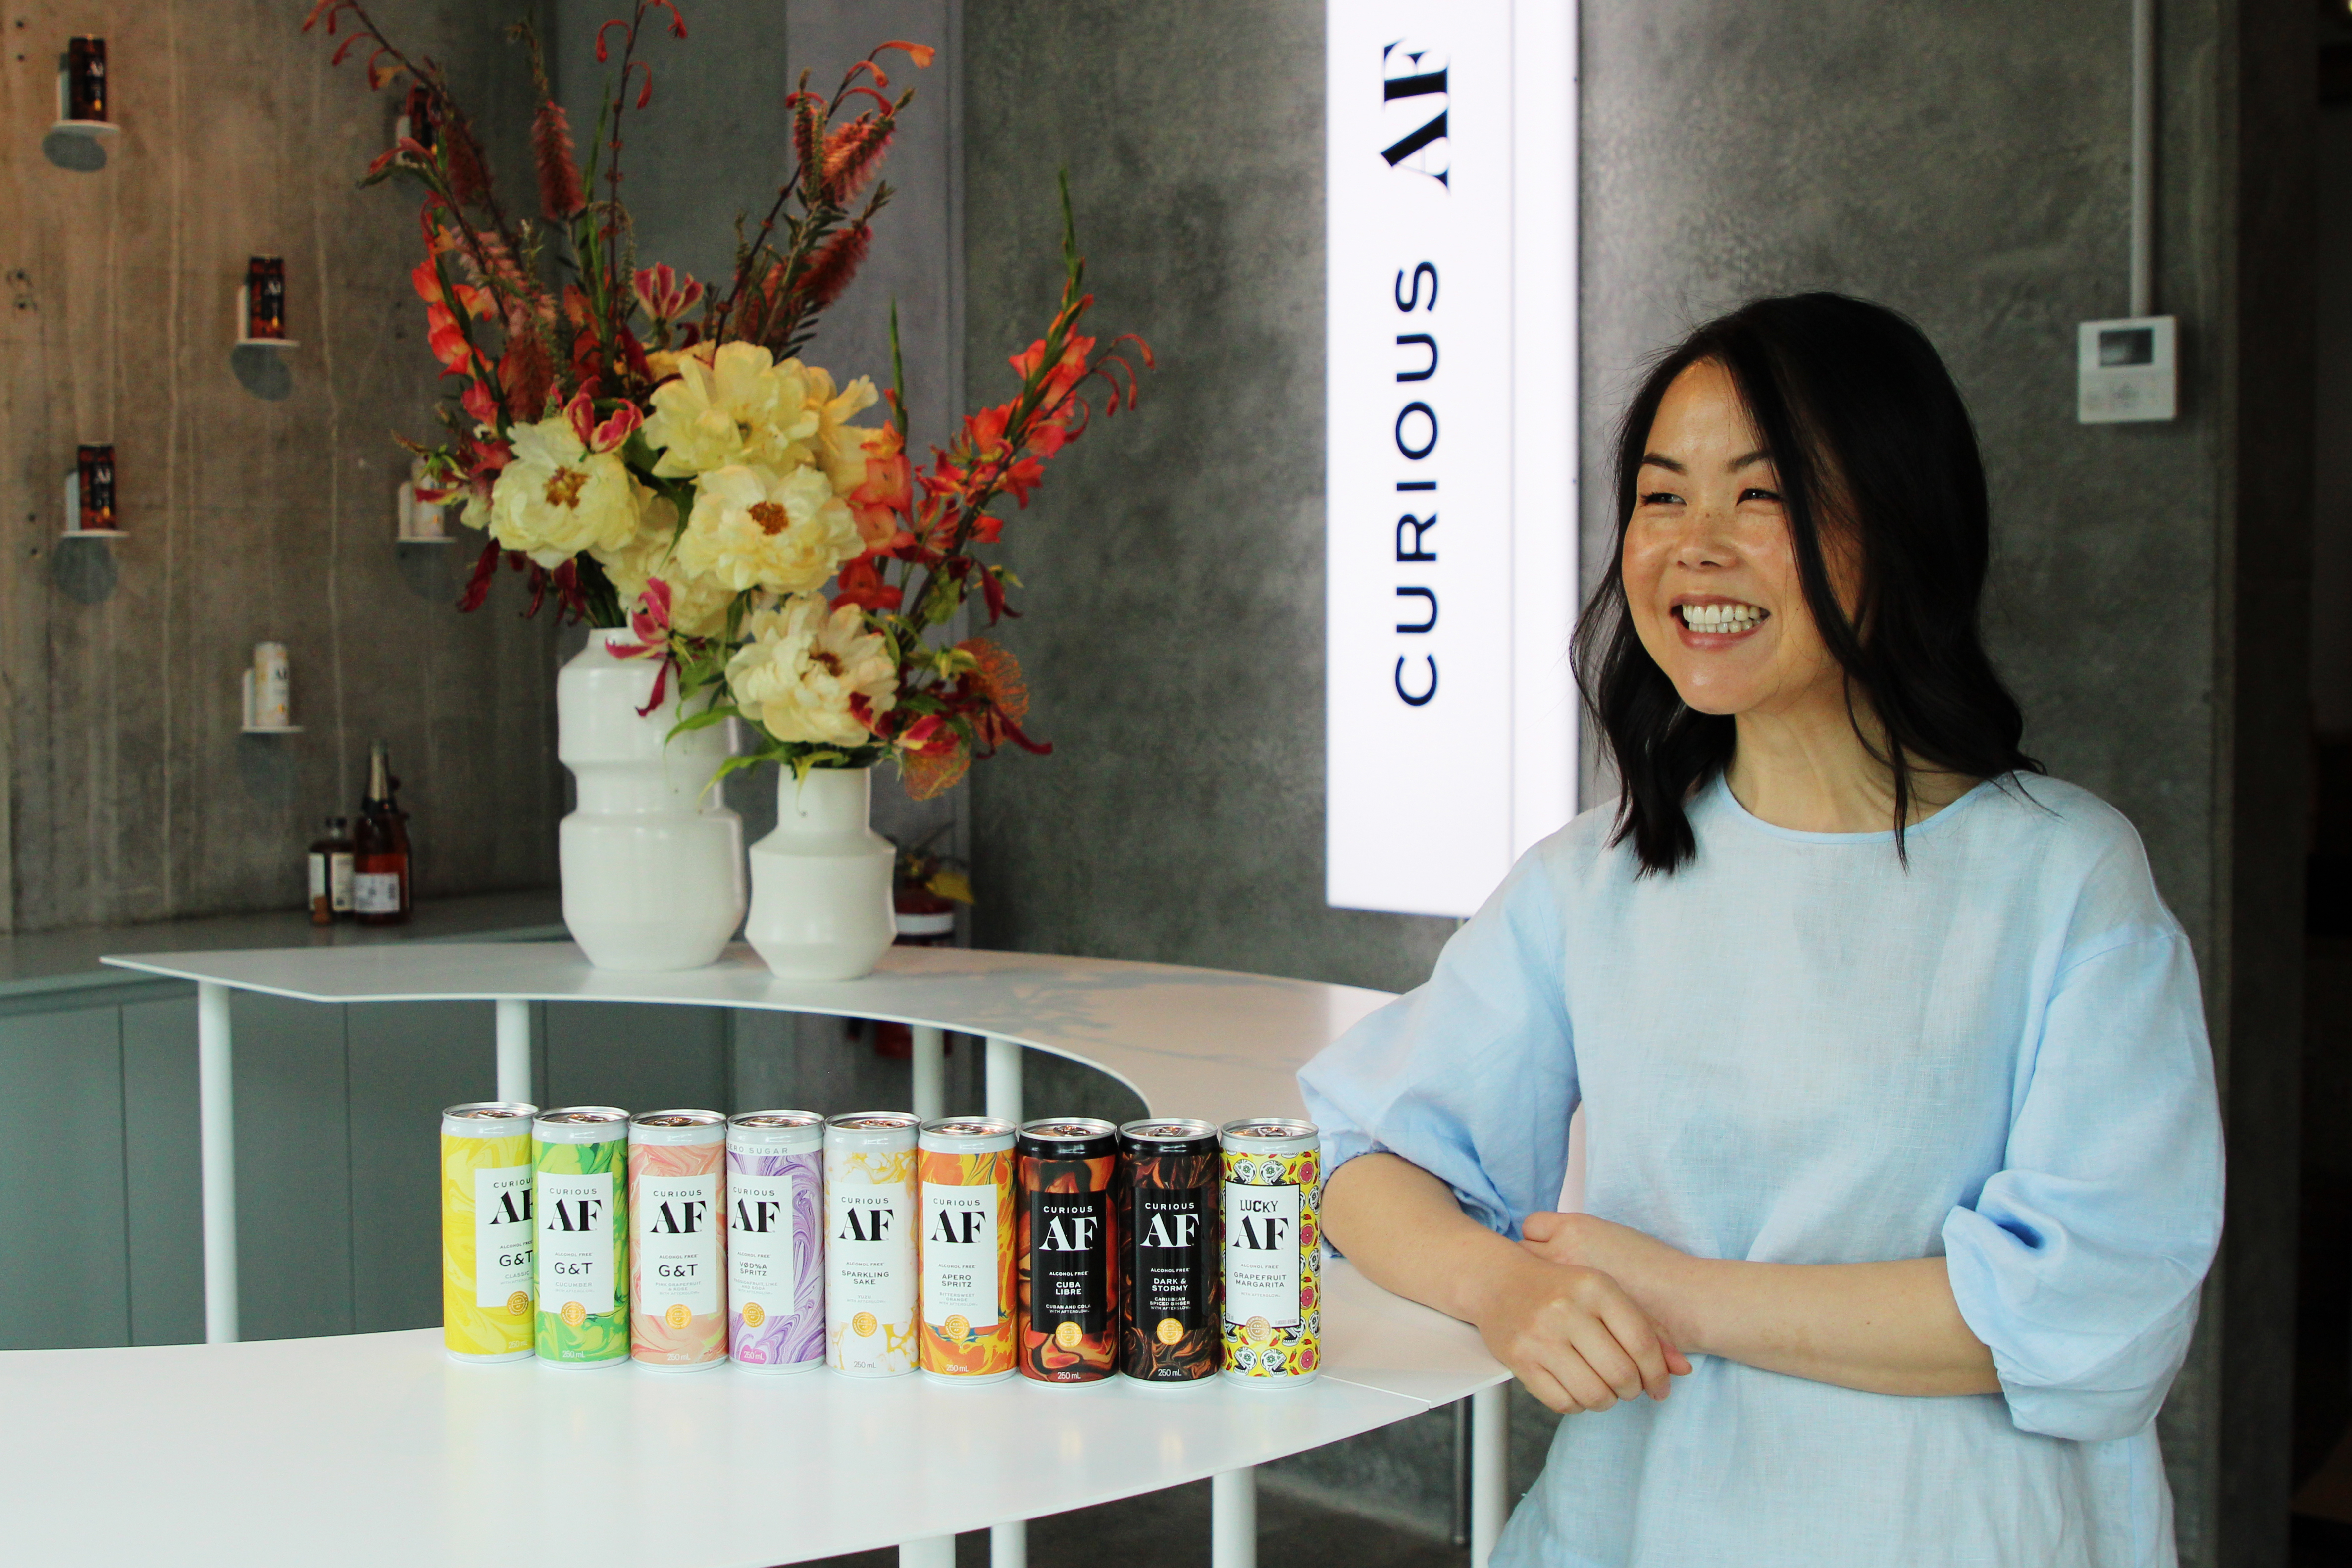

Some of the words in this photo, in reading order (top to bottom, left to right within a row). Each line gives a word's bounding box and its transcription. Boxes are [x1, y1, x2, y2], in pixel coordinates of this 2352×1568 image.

[1380, 37, 1450, 197] AF
[1395, 261, 1439, 707] CURIOUS
[727, 1142, 743, 1152] ZERO
[493, 1178, 532, 1188] CURIOU
[733, 1187, 775, 1196] CURIOUS
[546, 1198, 603, 1231] AF
[649, 1200, 707, 1233] AF
[731, 1197, 781, 1233] AF
[1240, 1199, 1278, 1213] LUCKY
[838, 1207, 894, 1241] AF
[930, 1209, 986, 1243] AF
[1039, 1216, 1098, 1251] AF
[1140, 1212, 1199, 1248] AF
[1232, 1215, 1289, 1250] AF
[499, 1250, 533, 1266] G&T
[554, 1262, 593, 1274] G&T
[505, 1270, 530, 1279] CLASSIC
[659, 1264, 698, 1277] G&T
[1234, 1272, 1287, 1281] GRAPEFRUIT
[1236, 1279, 1285, 1288] MARGARITA
